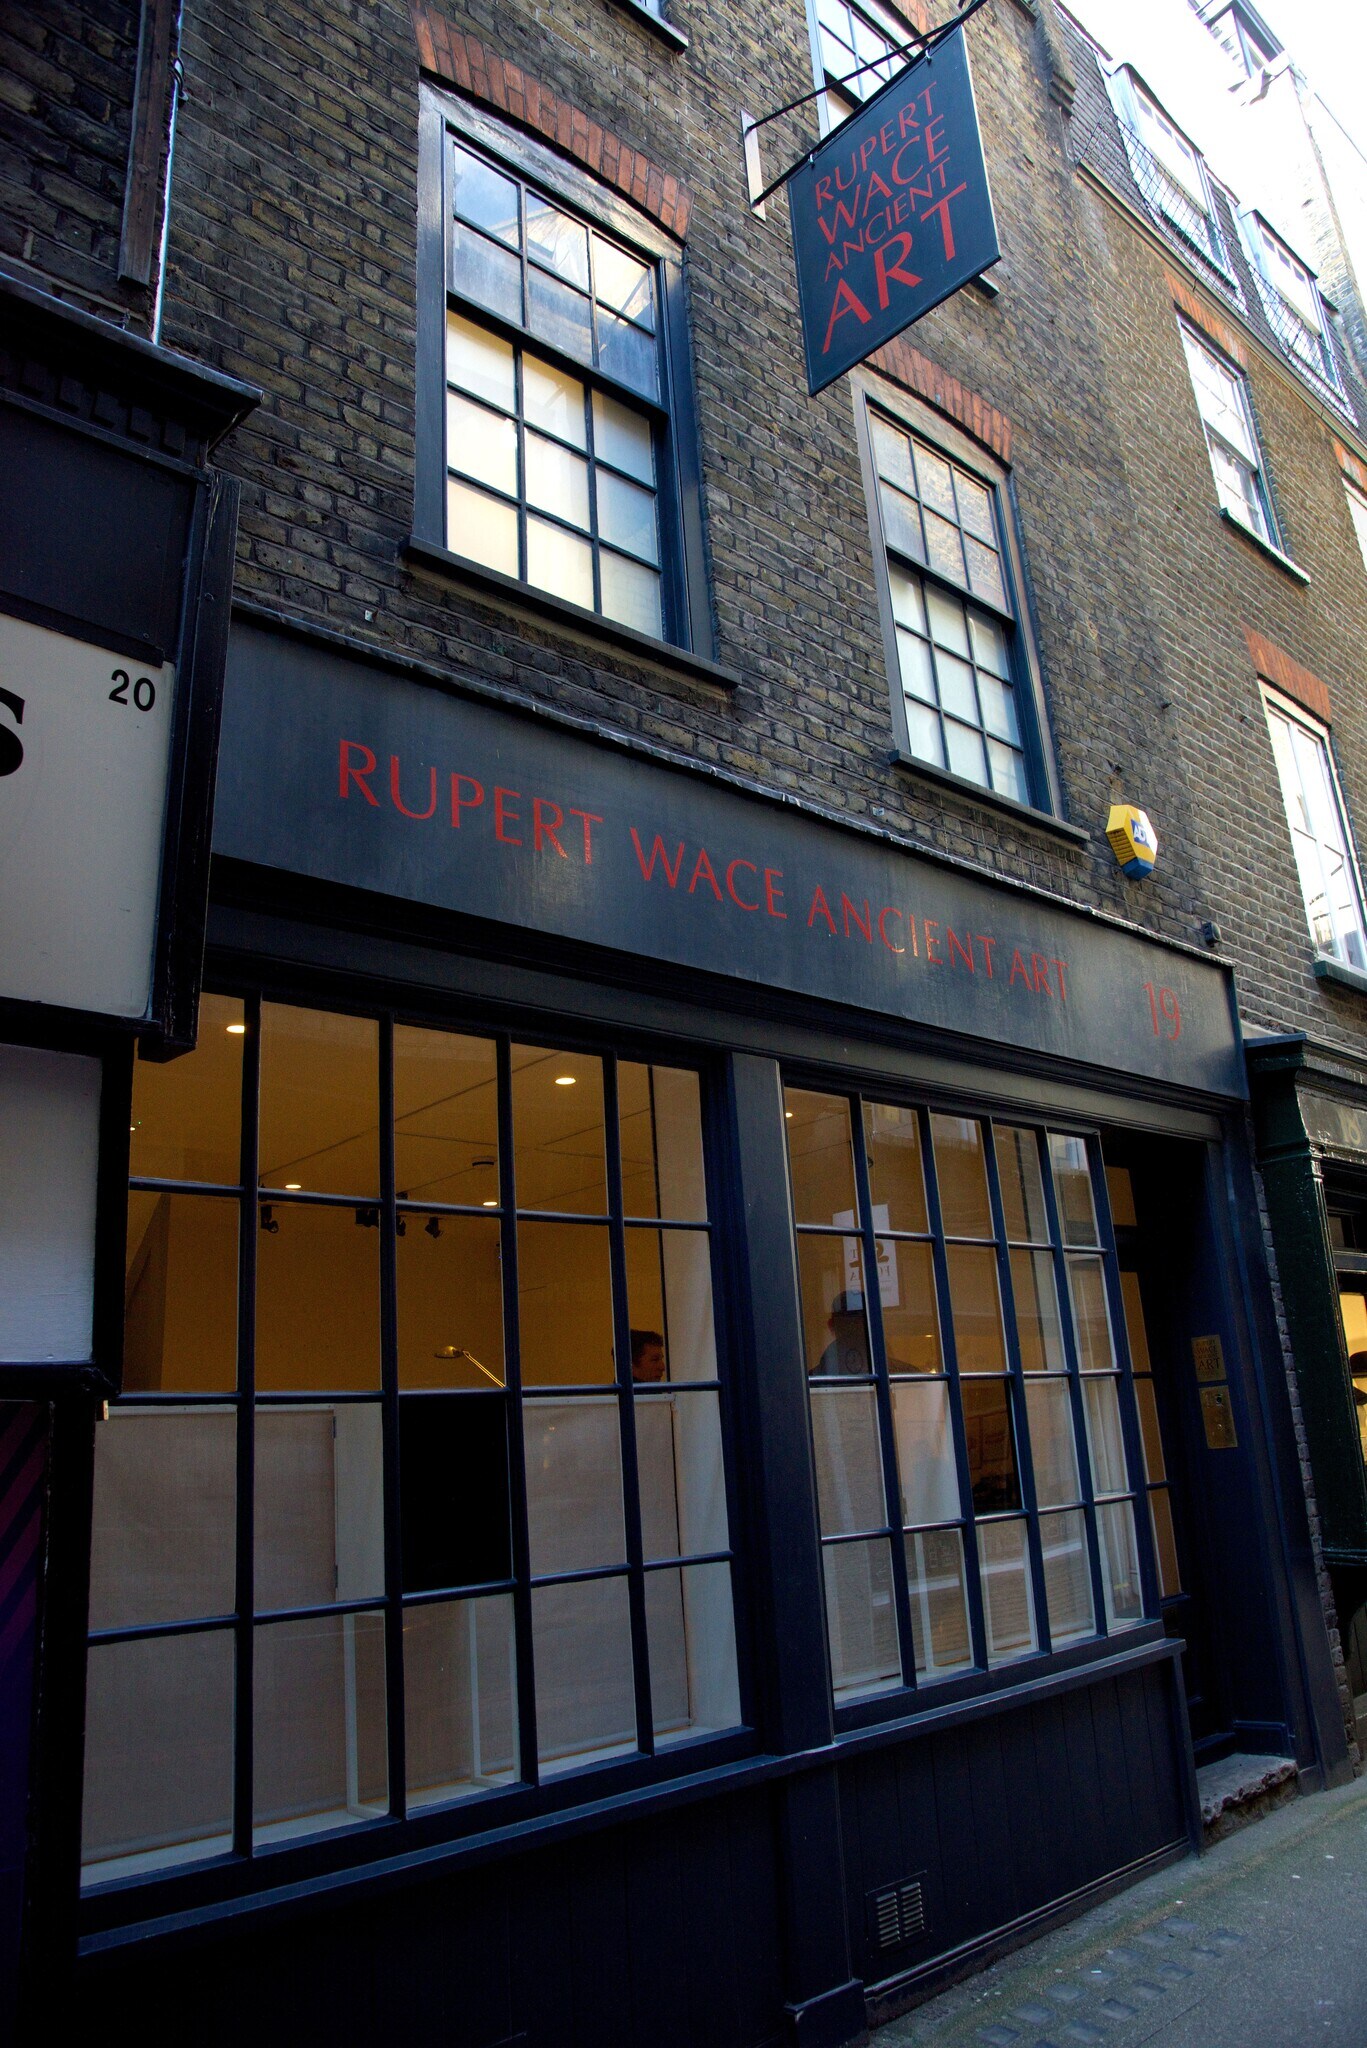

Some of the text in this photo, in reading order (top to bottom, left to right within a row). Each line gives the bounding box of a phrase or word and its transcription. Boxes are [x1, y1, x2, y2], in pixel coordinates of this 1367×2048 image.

[814, 81, 938, 211] RUPERT
[817, 113, 950, 246] WACE
[822, 181, 967, 355] ART
[824, 156, 951, 282] ANCIENT
[108, 669, 156, 712] 20
[338, 738, 1182, 1041] RUPERT WACE ANCIENT ART 19
[1198, 1357, 1221, 1371] ART
